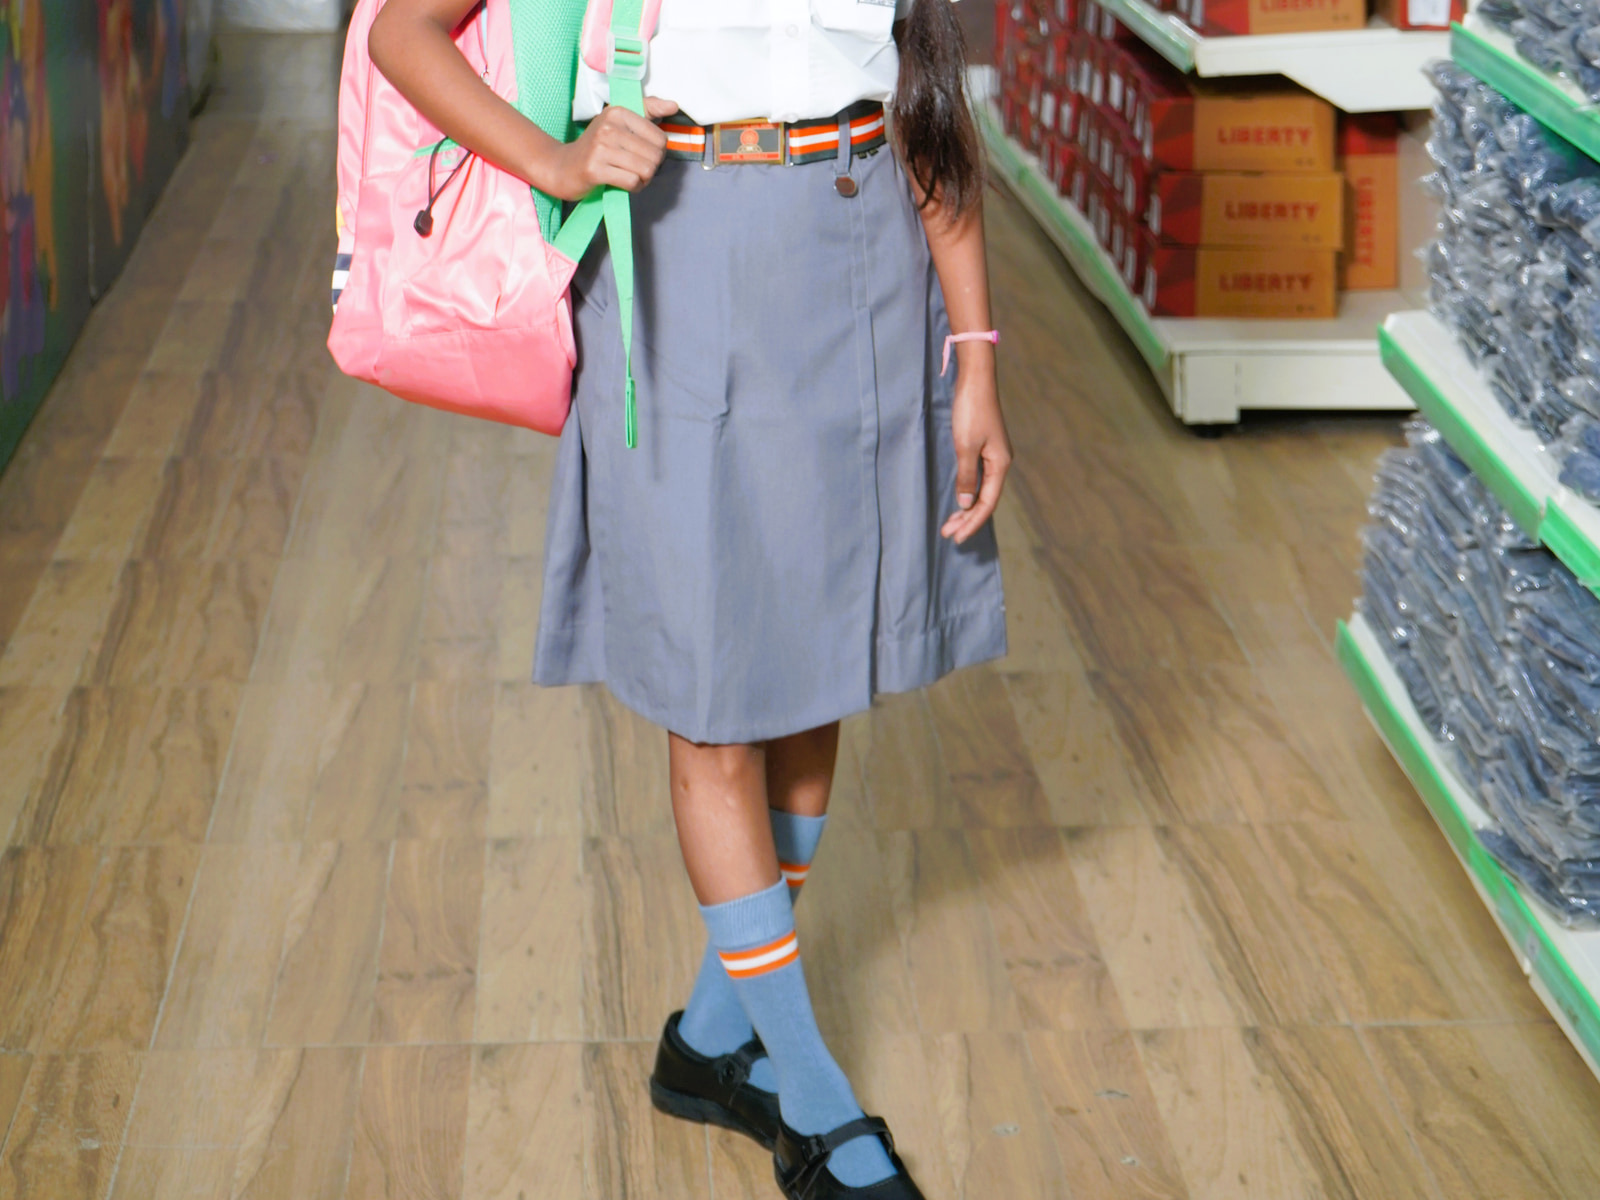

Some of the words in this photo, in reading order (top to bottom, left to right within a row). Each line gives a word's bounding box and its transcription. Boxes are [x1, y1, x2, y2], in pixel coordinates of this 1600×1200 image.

[1217, 125, 1312, 146] LIBERTY
[1226, 201, 1319, 221] LIBERTY
[1218, 272, 1312, 292] LIBERTY
